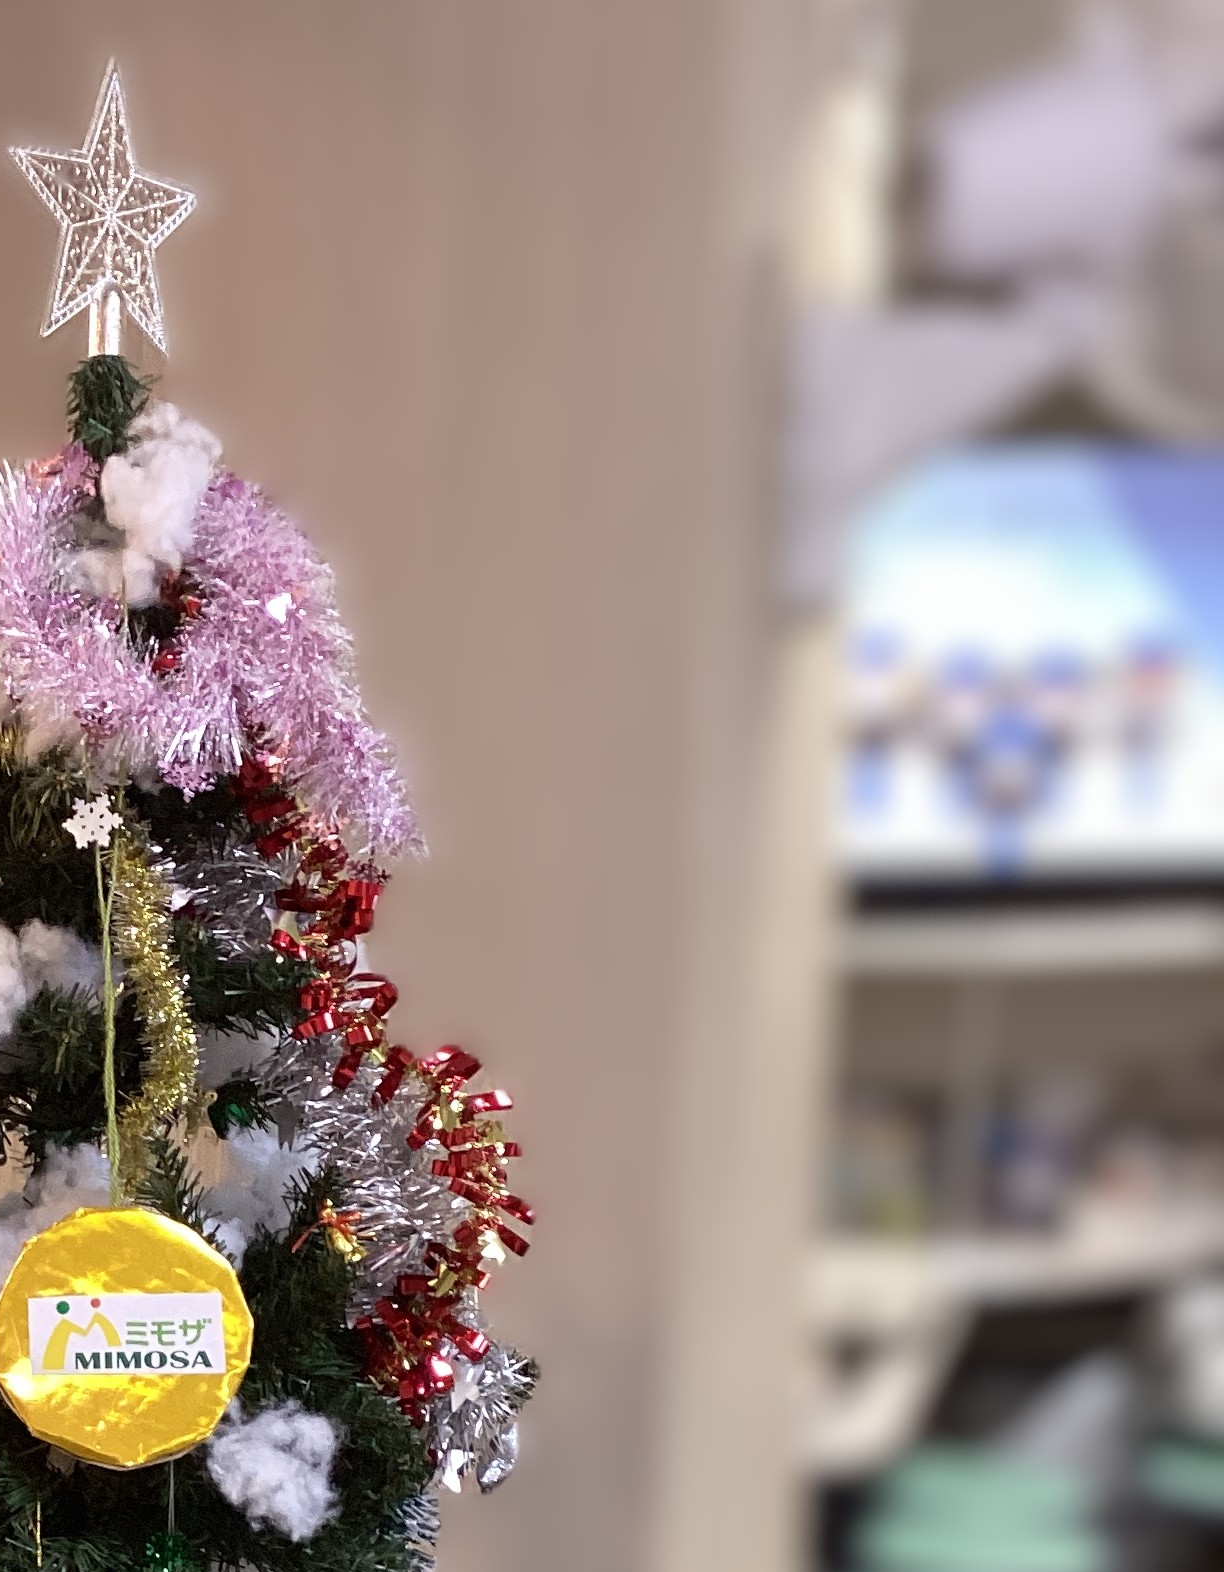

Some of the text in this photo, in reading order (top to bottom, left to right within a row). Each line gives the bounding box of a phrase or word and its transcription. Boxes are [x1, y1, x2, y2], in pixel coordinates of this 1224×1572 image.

[125, 1318, 212, 1346] ミモザ
[75, 1350, 213, 1369] MIMOSA
